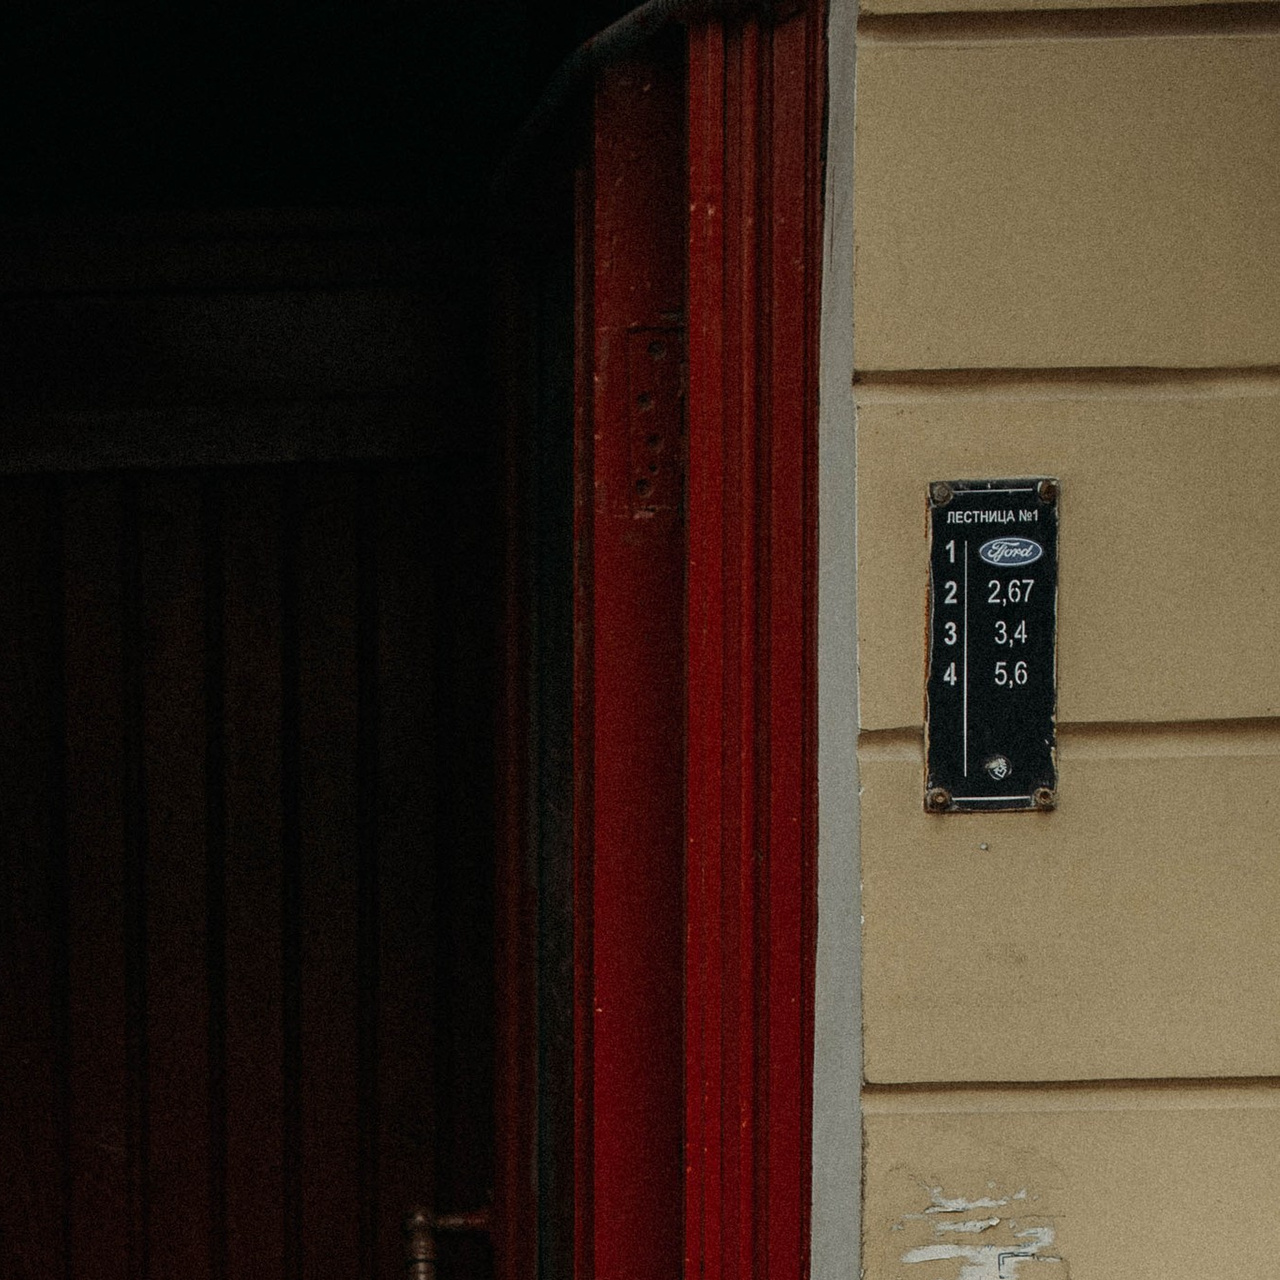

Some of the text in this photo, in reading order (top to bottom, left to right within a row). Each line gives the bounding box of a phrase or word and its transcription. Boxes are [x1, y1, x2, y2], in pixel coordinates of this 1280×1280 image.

[946, 509, 1039, 524] ЛЕСТНИЦА №1
[945, 539, 1034, 563] 1 Ford
[944, 579, 1035, 607] 2 2,67
[944, 620, 1028, 648] 3 3,4
[943, 661, 1028, 689] 4 5,6
